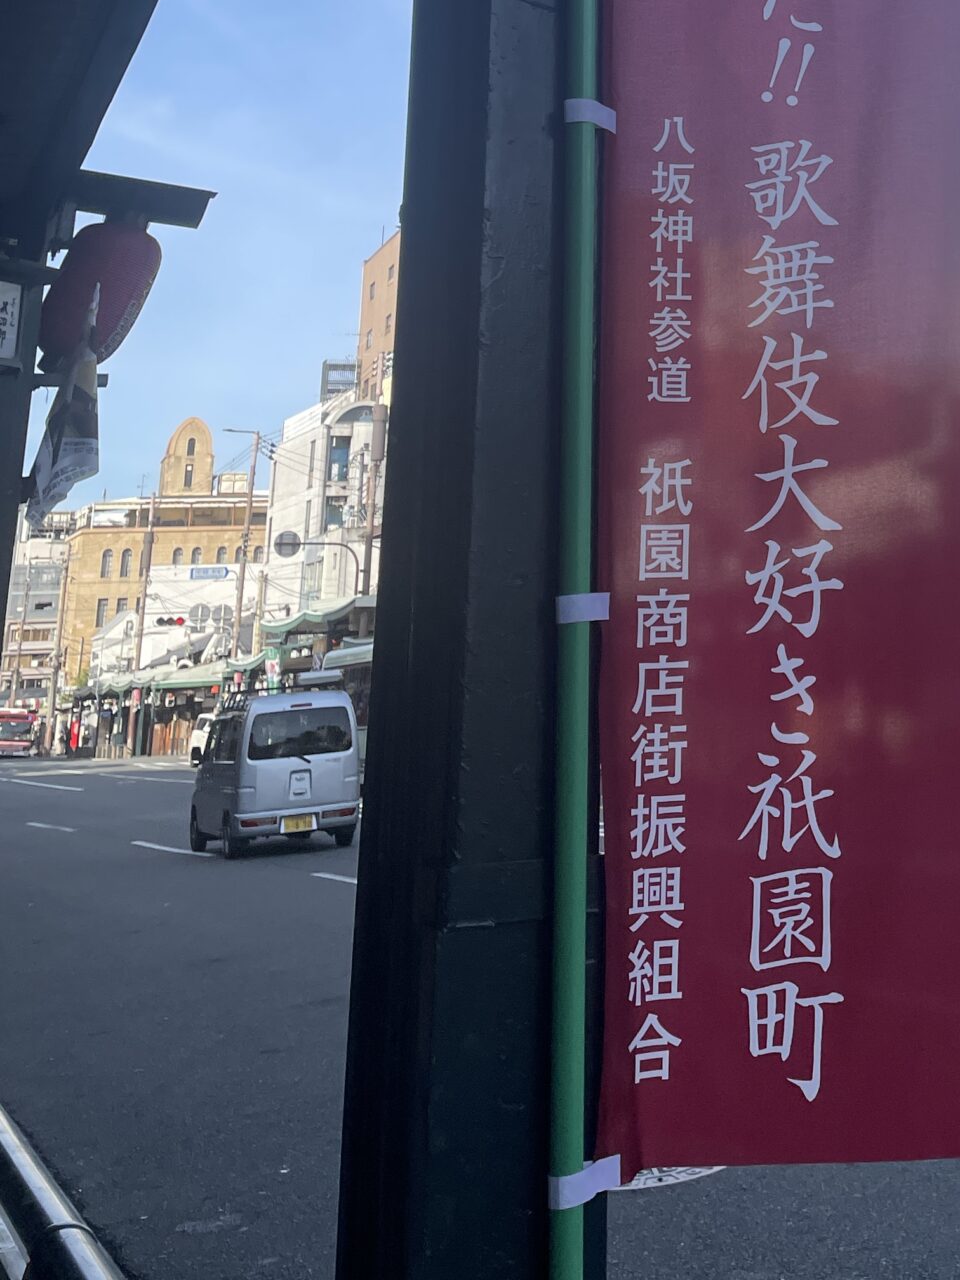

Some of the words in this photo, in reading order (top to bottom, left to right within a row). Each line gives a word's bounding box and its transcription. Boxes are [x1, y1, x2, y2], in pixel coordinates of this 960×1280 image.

[647, 117, 695, 402] 八坂神社参道
[628, 459, 693, 1084] 祇園商店街振興組合
